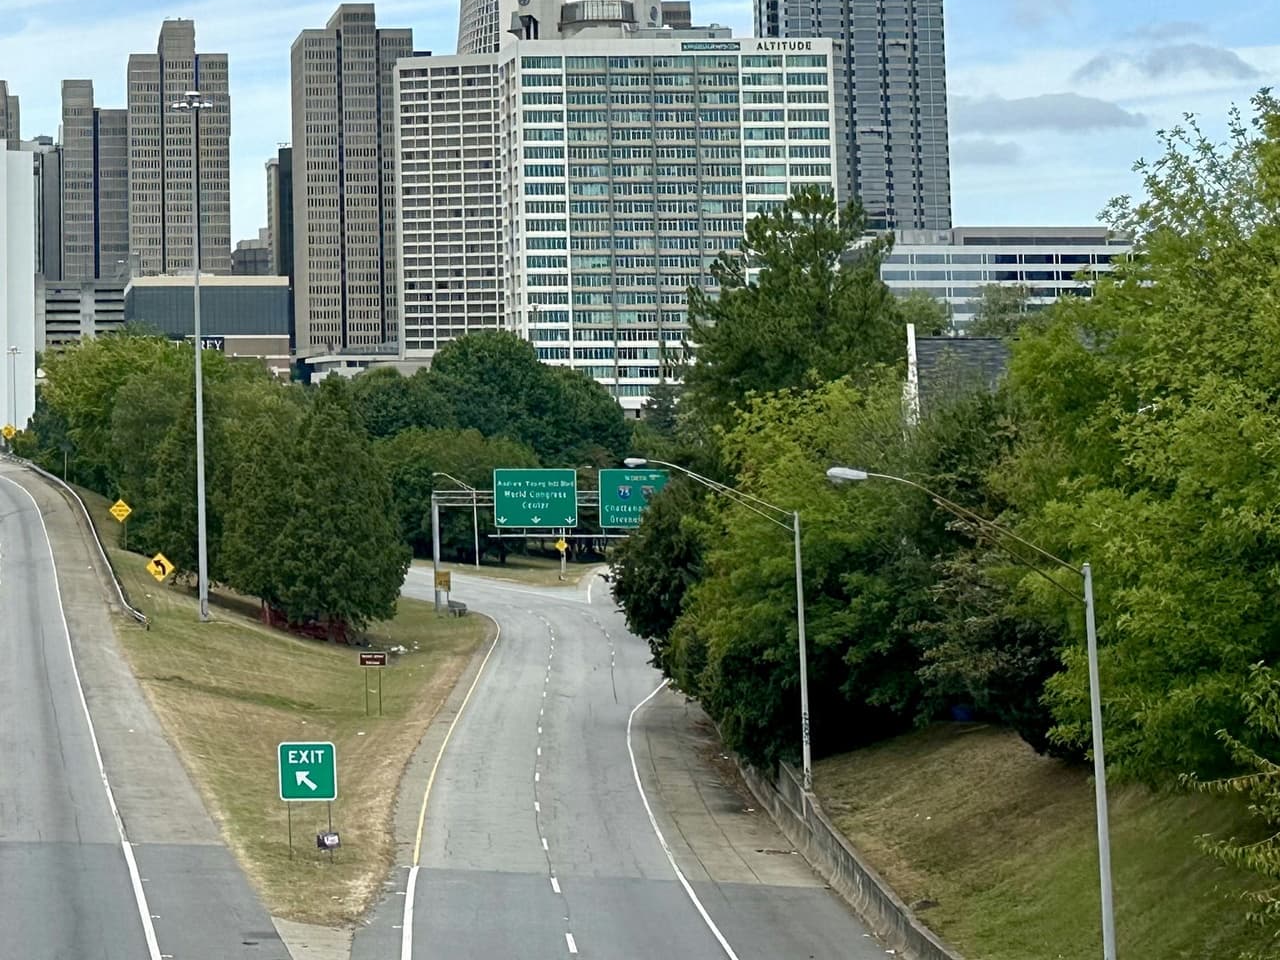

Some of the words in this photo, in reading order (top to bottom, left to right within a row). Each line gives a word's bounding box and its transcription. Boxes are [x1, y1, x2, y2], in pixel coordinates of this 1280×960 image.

[756, 41, 812, 51] ALTITUDE
[504, 490, 527, 498] World
[288, 750, 325, 764] EXIT
